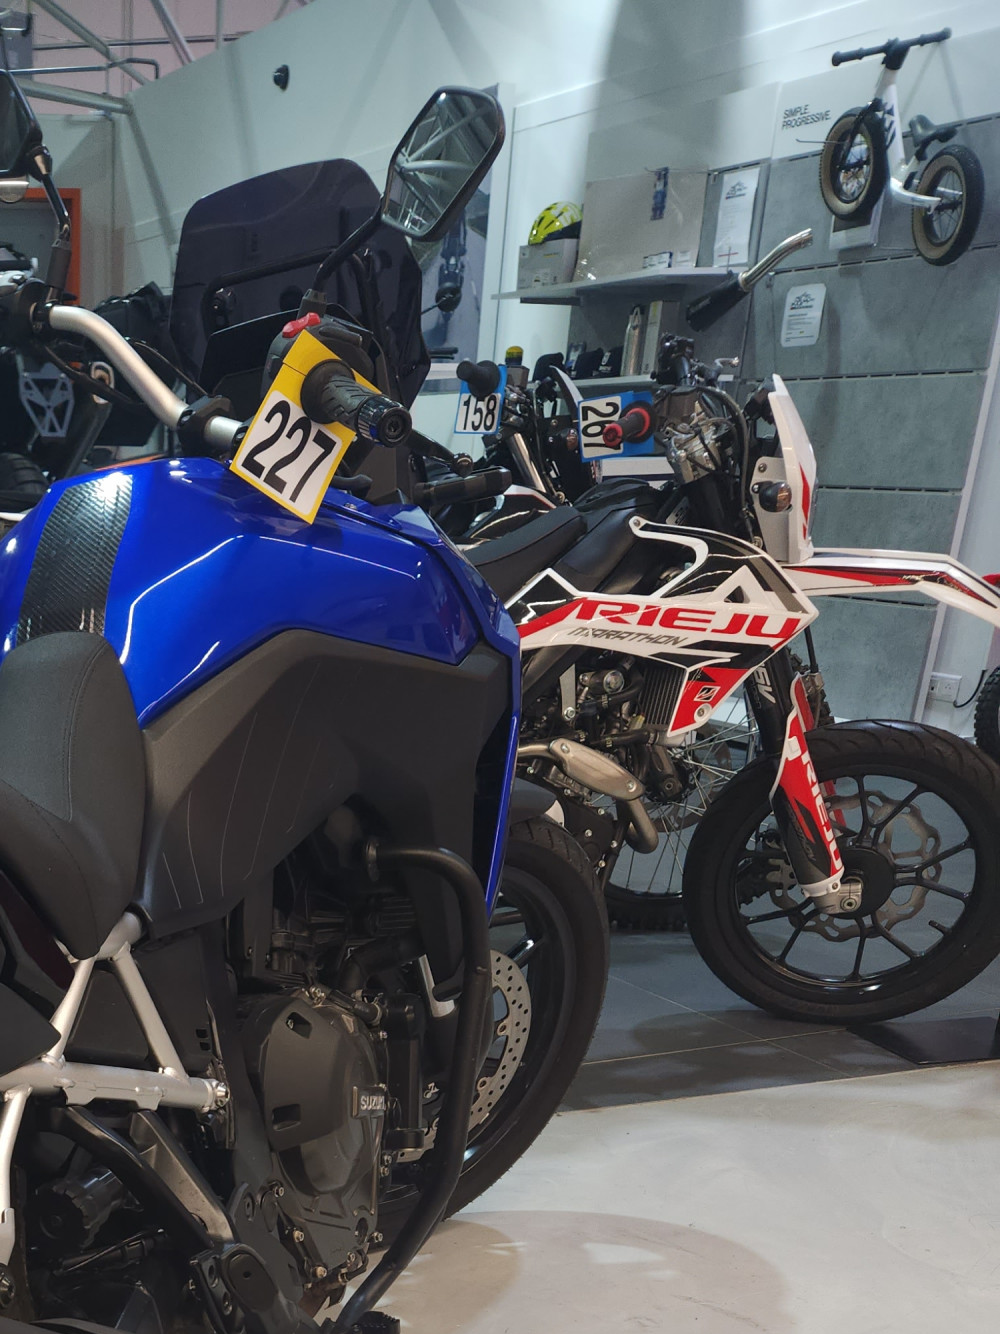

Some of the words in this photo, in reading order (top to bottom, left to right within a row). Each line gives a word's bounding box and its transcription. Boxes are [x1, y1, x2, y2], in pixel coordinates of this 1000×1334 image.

[461, 394, 497, 431] 158
[241, 400, 337, 503] 227
[567, 626, 688, 646] MARATHON
[575, 598, 802, 640] RIEJU
